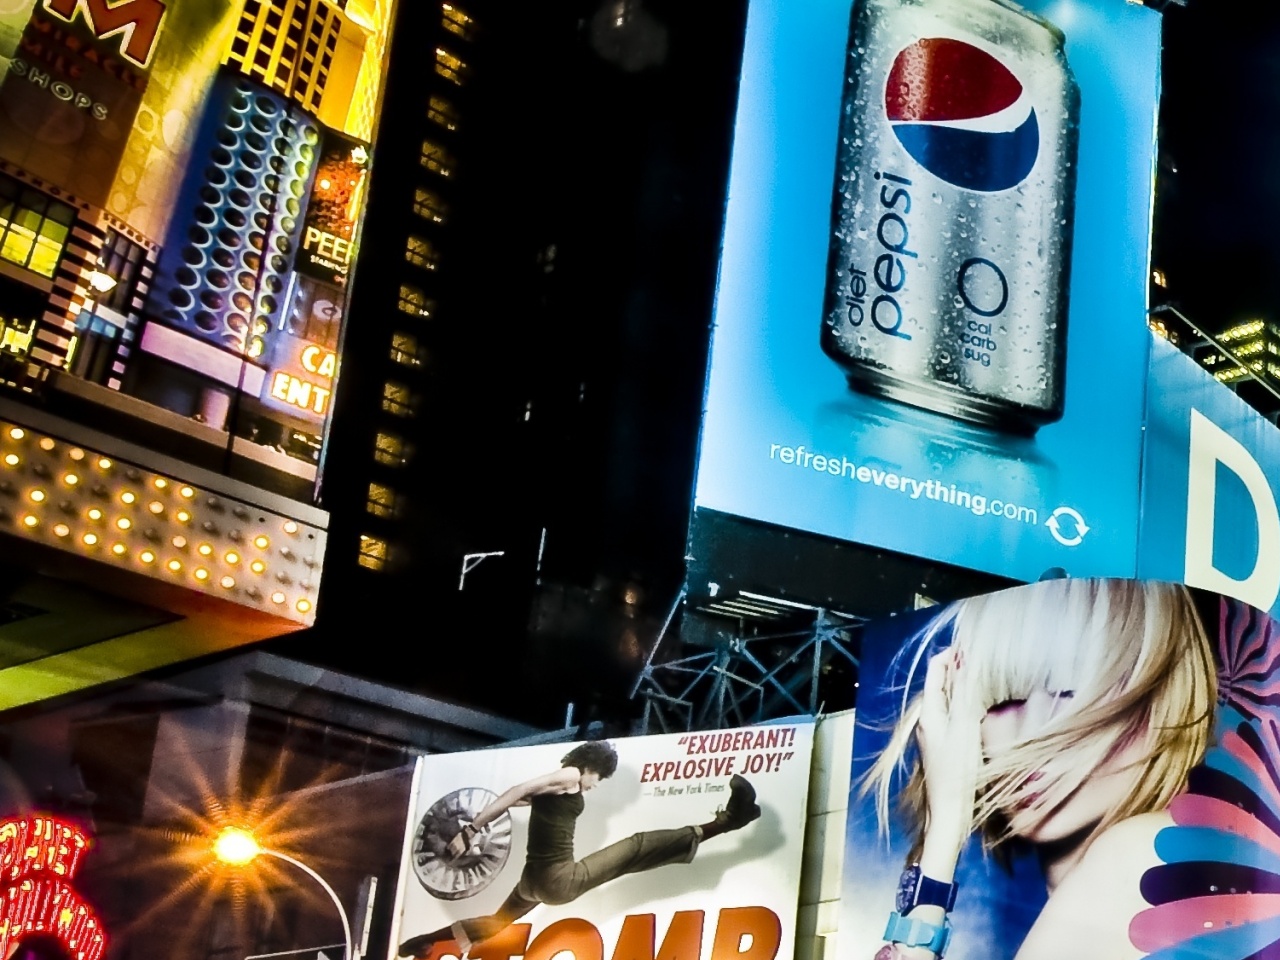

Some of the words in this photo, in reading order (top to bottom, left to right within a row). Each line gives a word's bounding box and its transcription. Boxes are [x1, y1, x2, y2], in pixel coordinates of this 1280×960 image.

[10, 58, 109, 120] SHOPS
[870, 170, 918, 341] pepsi
[847, 262, 869, 327] diet
[967, 319, 993, 335] cal
[959, 333, 997, 353] carb
[963, 345, 992, 368] sug
[770, 443, 1039, 526] refresheverything.com
[640, 757, 736, 783] EXPLOSIVE
[654, 787, 667, 797] The
[668, 785, 682, 796] New
[686, 782, 702, 795] York
[705, 782, 725, 794] Times
